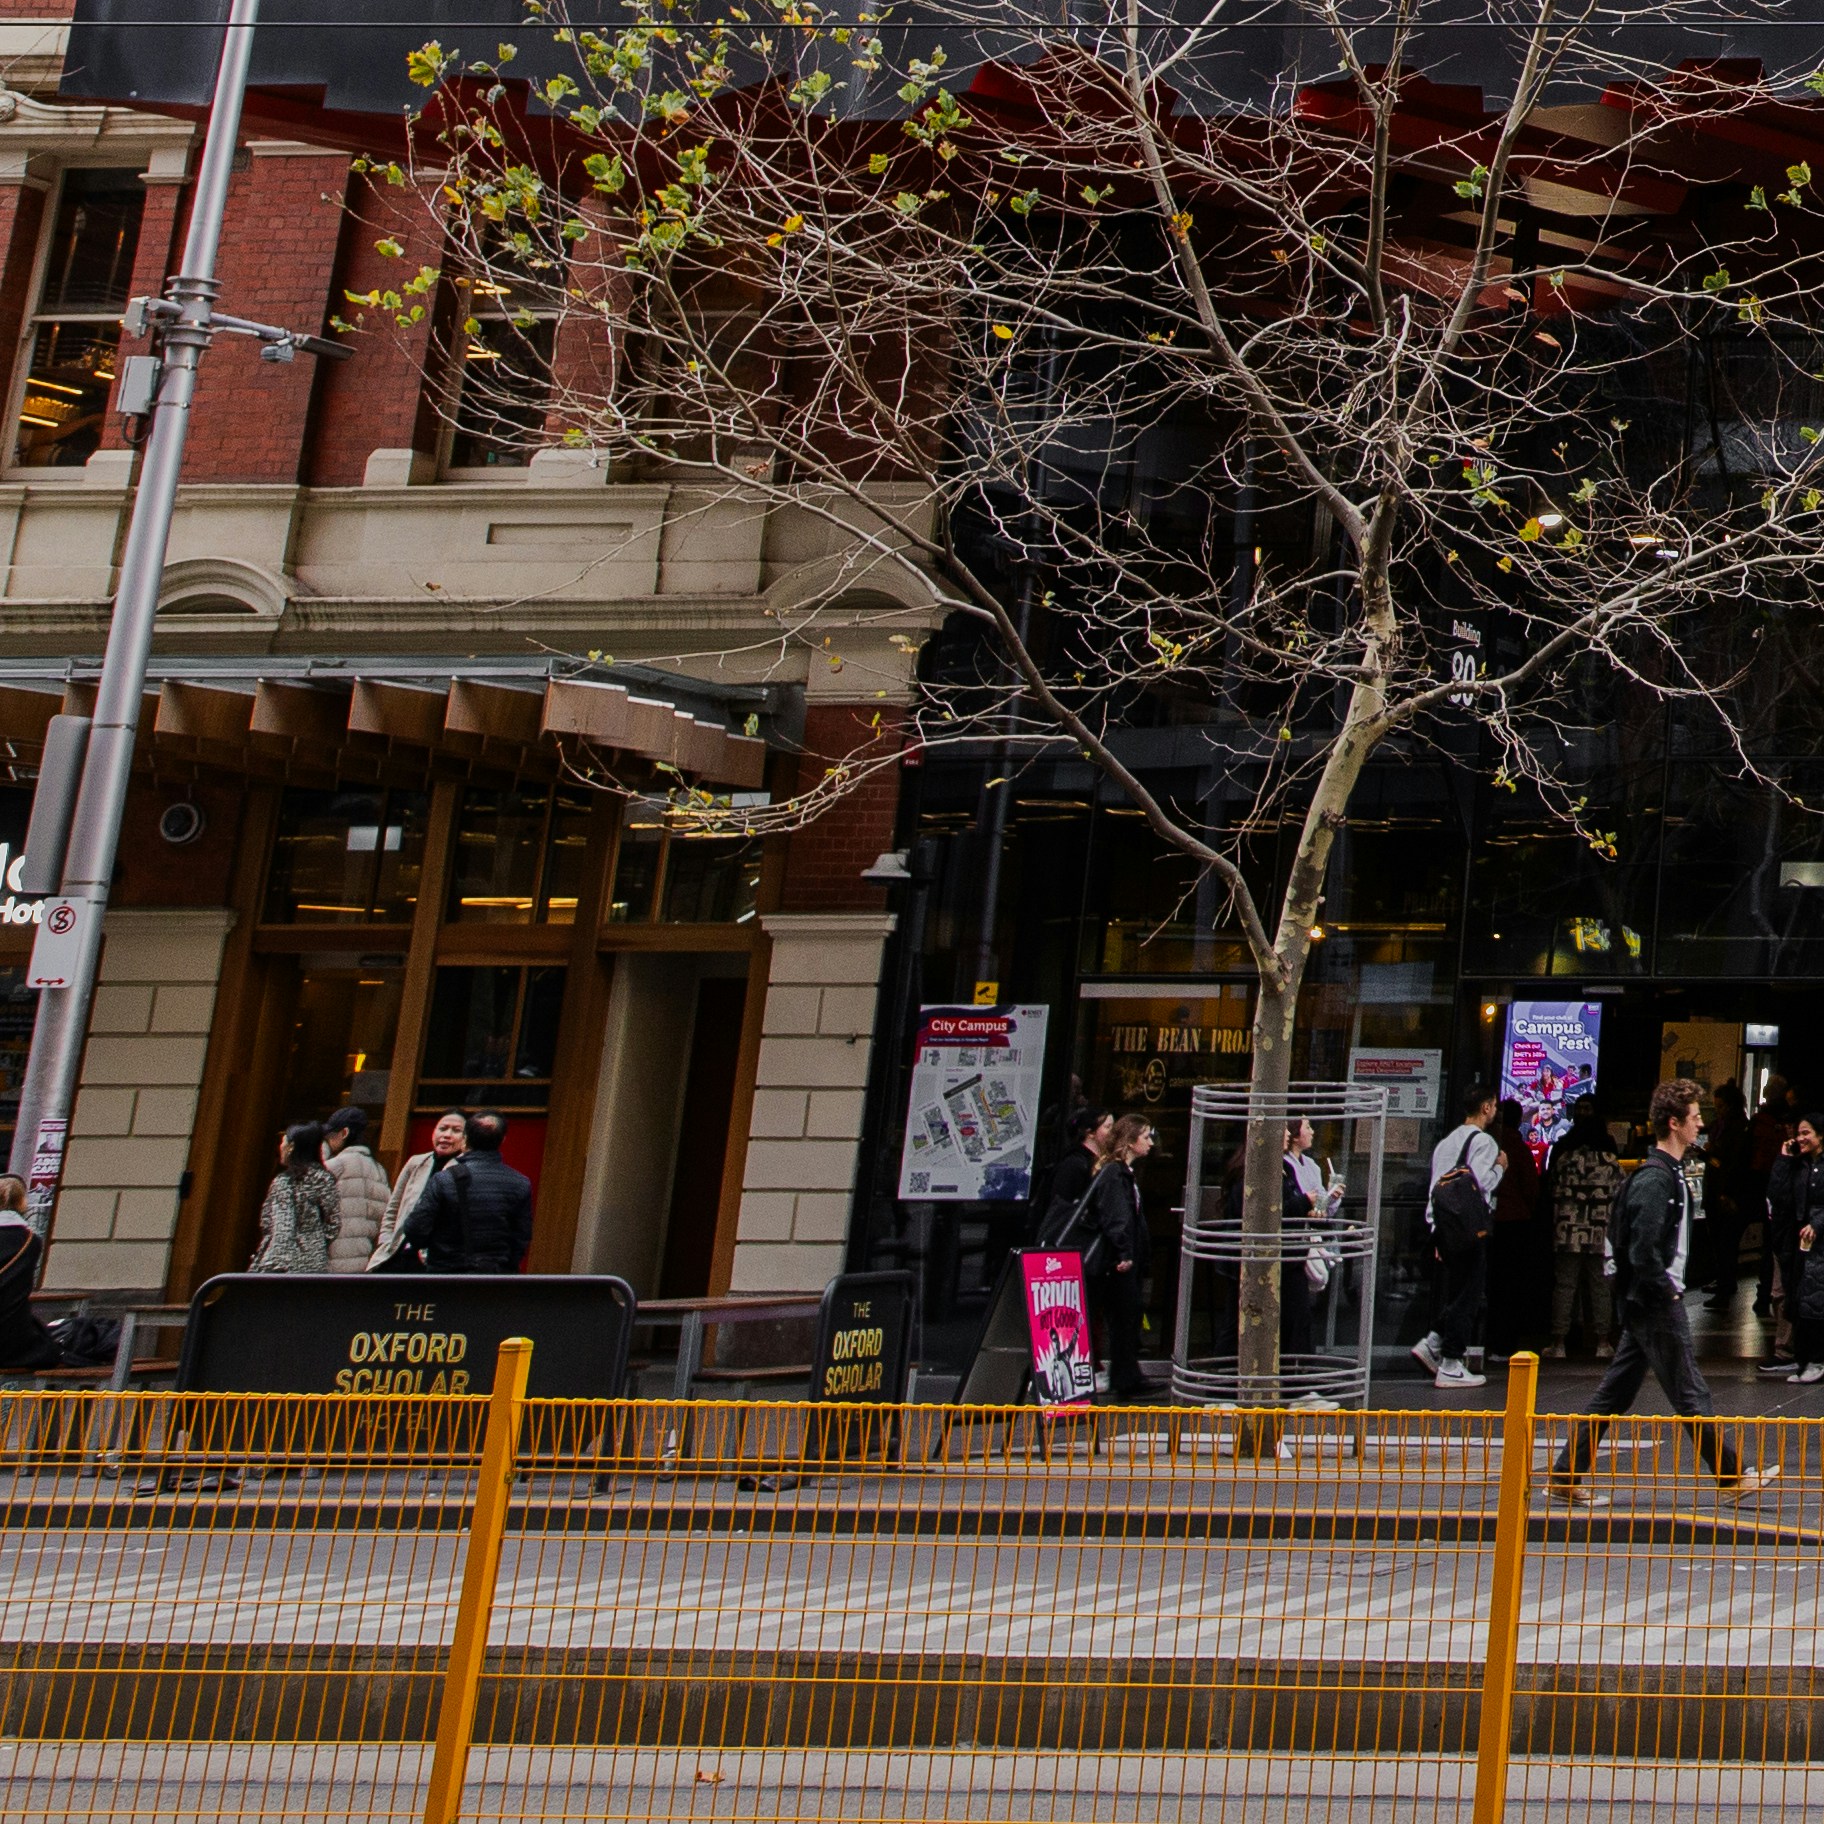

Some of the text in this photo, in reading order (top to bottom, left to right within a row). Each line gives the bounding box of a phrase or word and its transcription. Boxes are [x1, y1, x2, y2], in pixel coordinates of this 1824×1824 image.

[1452, 619, 1481, 648] Building
[1450, 651, 1476, 706] 80
[931, 1019, 1008, 1034] City Campus
[1112, 1026, 1254, 1054] THE BEAN PROJ
[1514, 1020, 1583, 1037] Campus
[1558, 1036, 1591, 1050] Fest
[853, 1301, 872, 1318] THE
[1030, 1279, 1081, 1316] TRIVIA
[394, 1303, 437, 1321] THE
[350, 1332, 468, 1363] OXFORD
[833, 1327, 884, 1360] OXFORD
[333, 1368, 471, 1395] SCHOLAR
[824, 1361, 884, 1396] SCHOLAR
